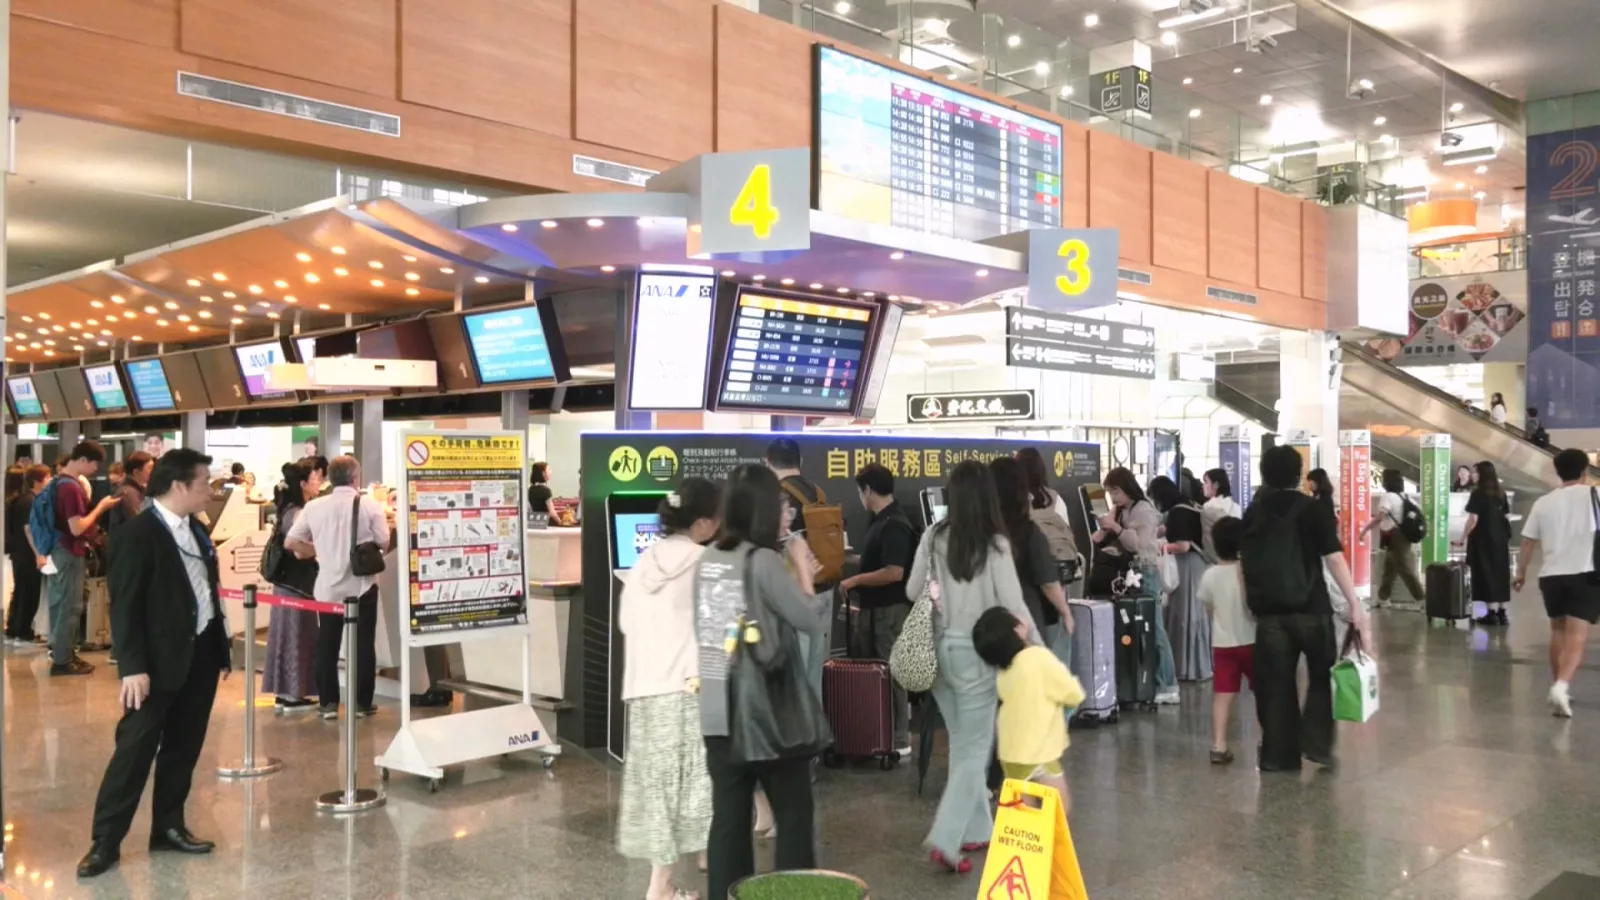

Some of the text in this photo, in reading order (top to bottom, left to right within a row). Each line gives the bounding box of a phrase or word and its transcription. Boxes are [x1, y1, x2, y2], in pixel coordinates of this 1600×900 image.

[1103, 70, 1121, 86] 1F
[1138, 69, 1149, 84] 1F
[1550, 140, 1596, 199] 2
[729, 164, 779, 238] 4
[1055, 239, 1092, 296] 3
[641, 284, 673, 298] ANA
[458, 362, 468, 378] 1
[827, 448, 941, 478] 自助服務區
[1356, 462, 1367, 483] Bag
[1242, 462, 1250, 509] Diamon
[1356, 485, 1368, 511] drop
[508, 733, 532, 746] ANA
[998, 834, 1044, 854] WET FLOOR
[1003, 826, 1041, 842] CAUTION
